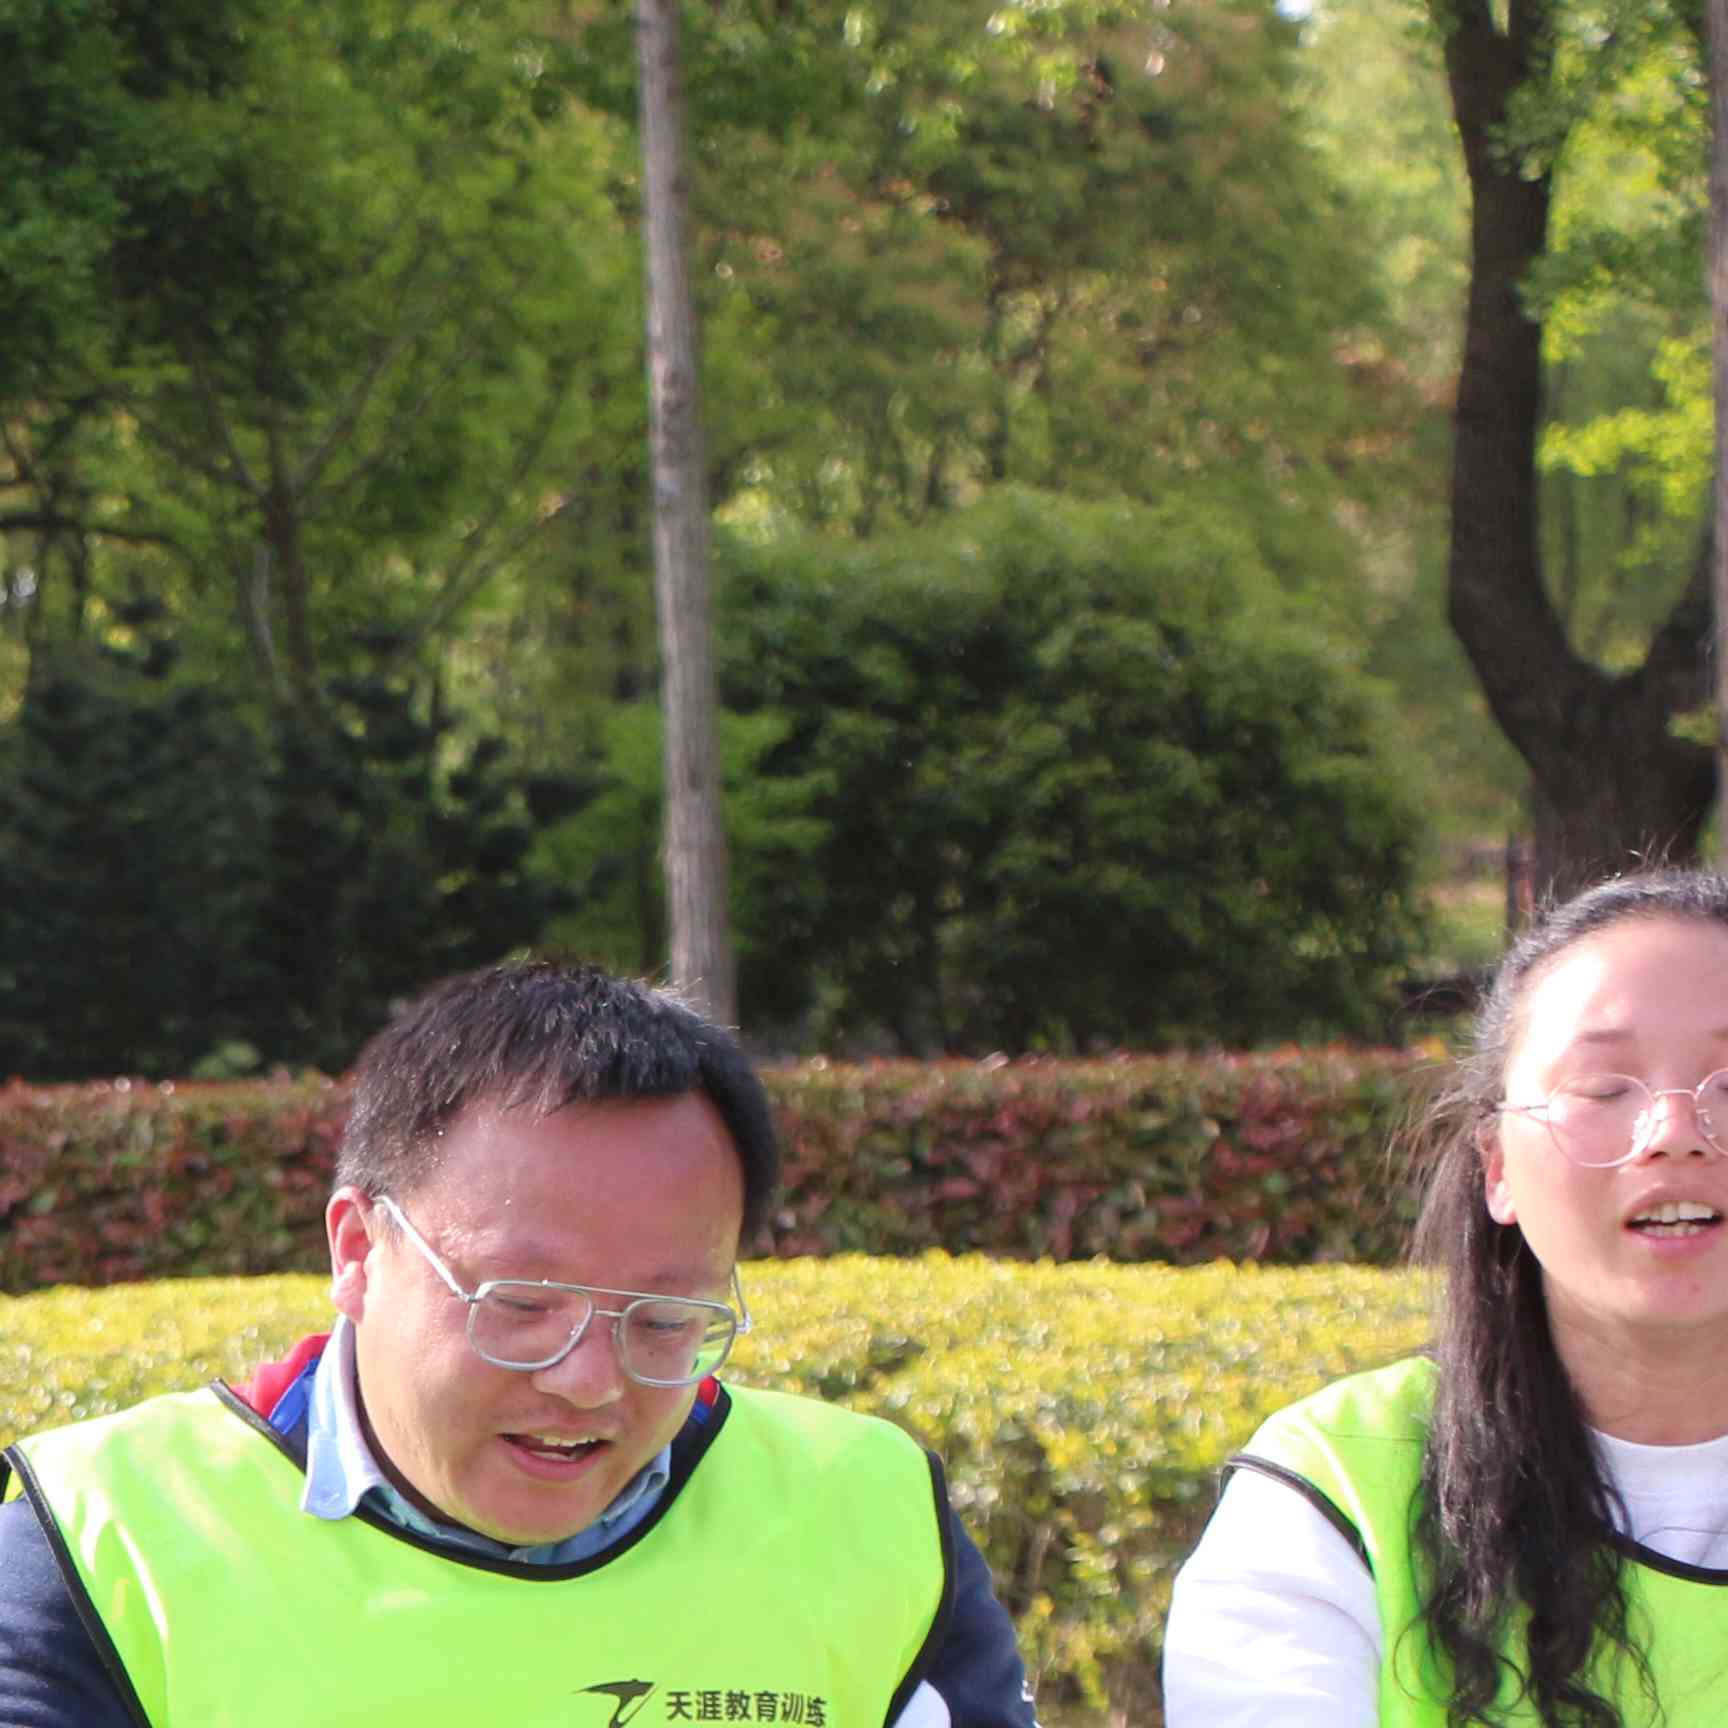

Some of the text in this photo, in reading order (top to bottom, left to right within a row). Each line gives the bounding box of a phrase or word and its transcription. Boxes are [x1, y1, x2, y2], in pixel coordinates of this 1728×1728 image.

[665, 1688, 828, 1728] 天涯教育训练
